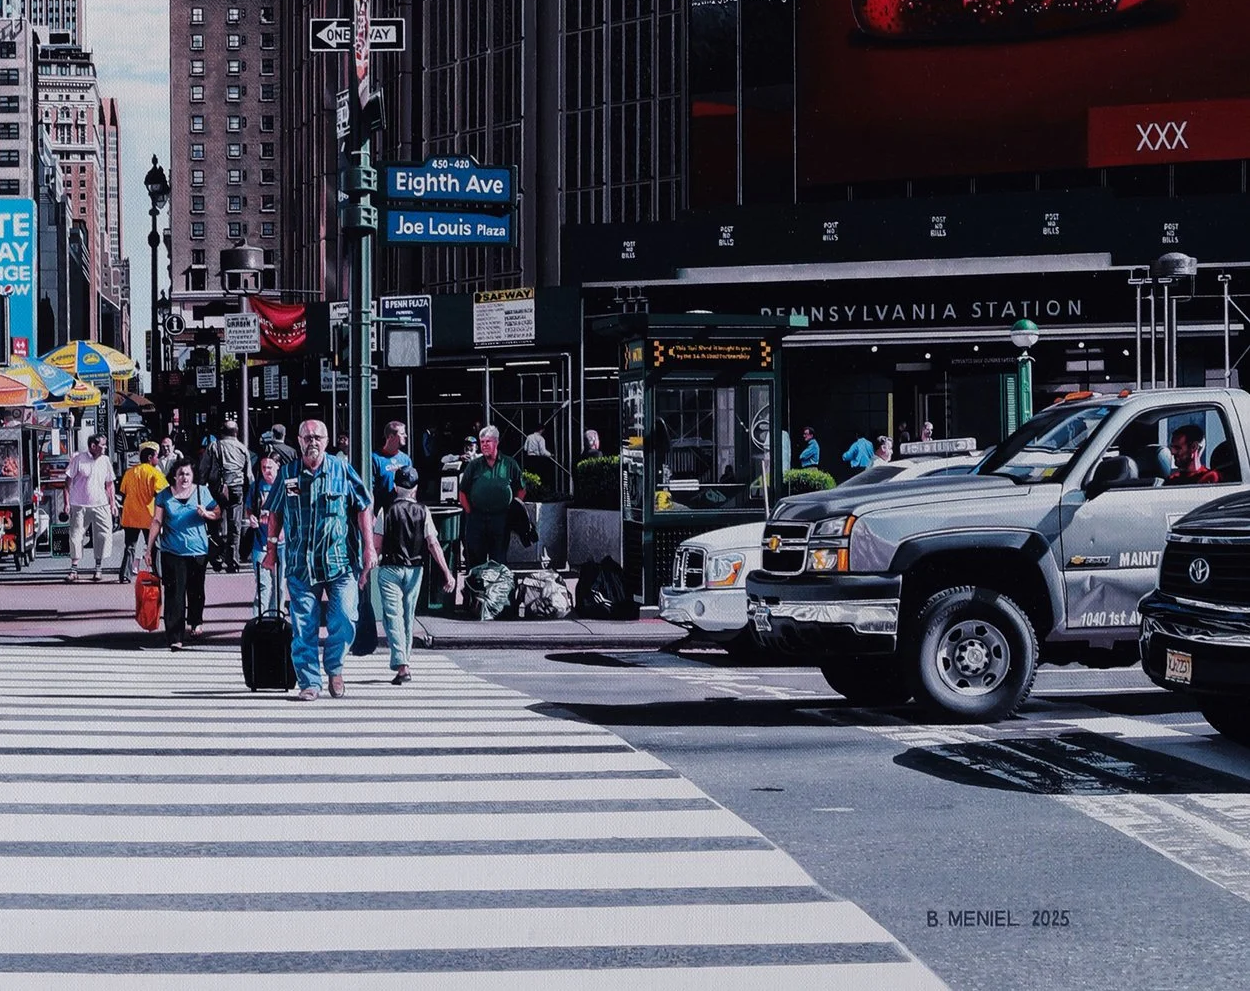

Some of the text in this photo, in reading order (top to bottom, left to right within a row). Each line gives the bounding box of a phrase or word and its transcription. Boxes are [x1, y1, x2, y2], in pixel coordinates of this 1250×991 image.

[327, 28, 350, 41] ONE
[1136, 121, 1189, 151] XXX
[396, 172, 504, 196] Eighth Ave
[396, 216, 506, 237] Joe Louis Plaza
[483, 290, 531, 301] SAFWAY
[971, 299, 1082, 318] STATION
[1119, 551, 1162, 567] MAINT
[1081, 612, 1106, 626] 1040
[1109, 611, 1125, 625] 1st
[927, 910, 1070, 927] B. MENIEL 2025
